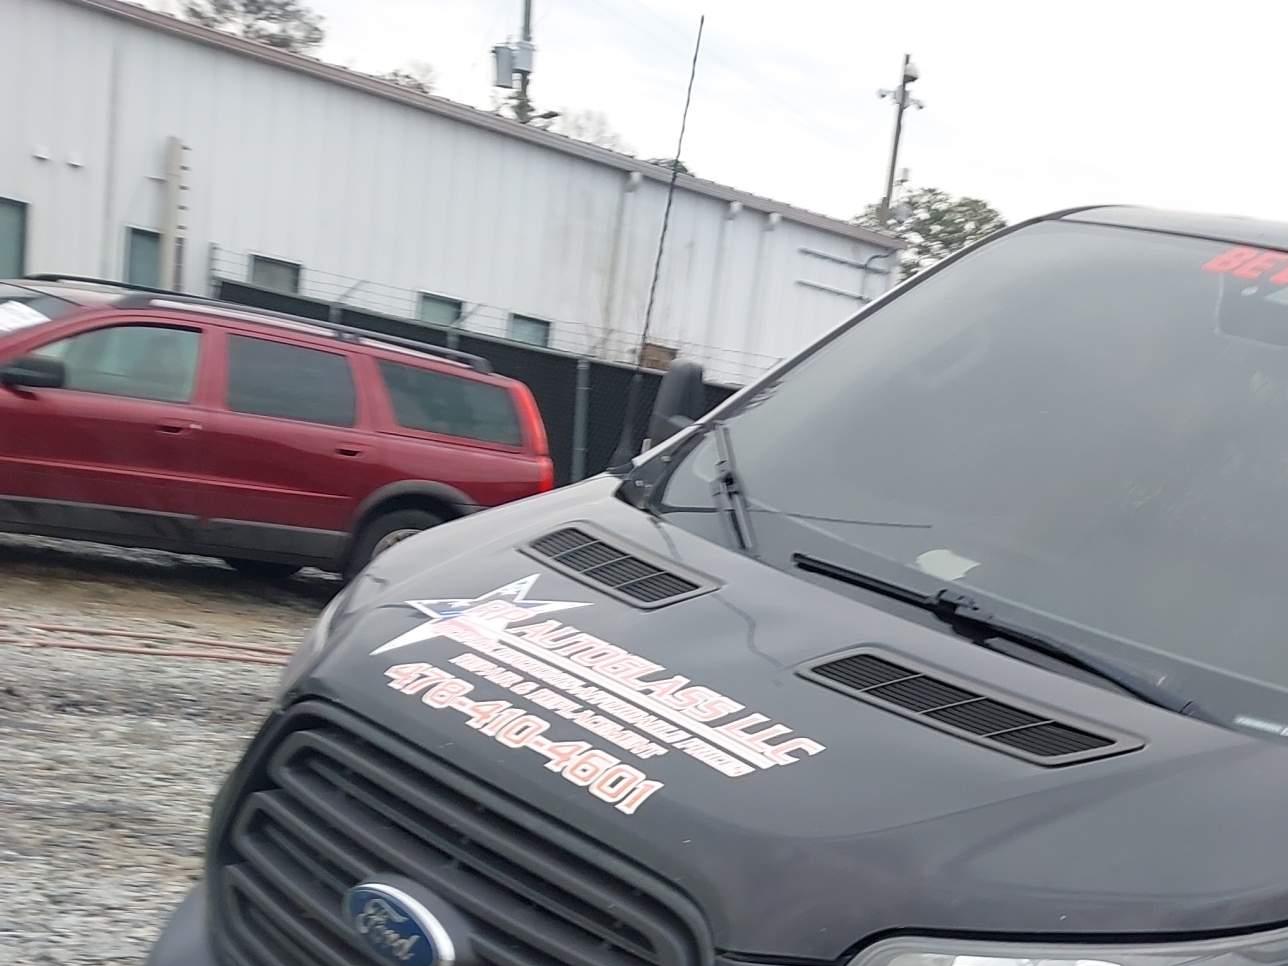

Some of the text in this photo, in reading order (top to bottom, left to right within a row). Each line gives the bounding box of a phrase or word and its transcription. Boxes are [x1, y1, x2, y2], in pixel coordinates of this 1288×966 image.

[384, 663, 664, 815] 478-410-4601
[504, 619, 746, 722] AUTOGLASS
[711, 713, 827, 765] LLC
[354, 898, 422, 961] Ford
